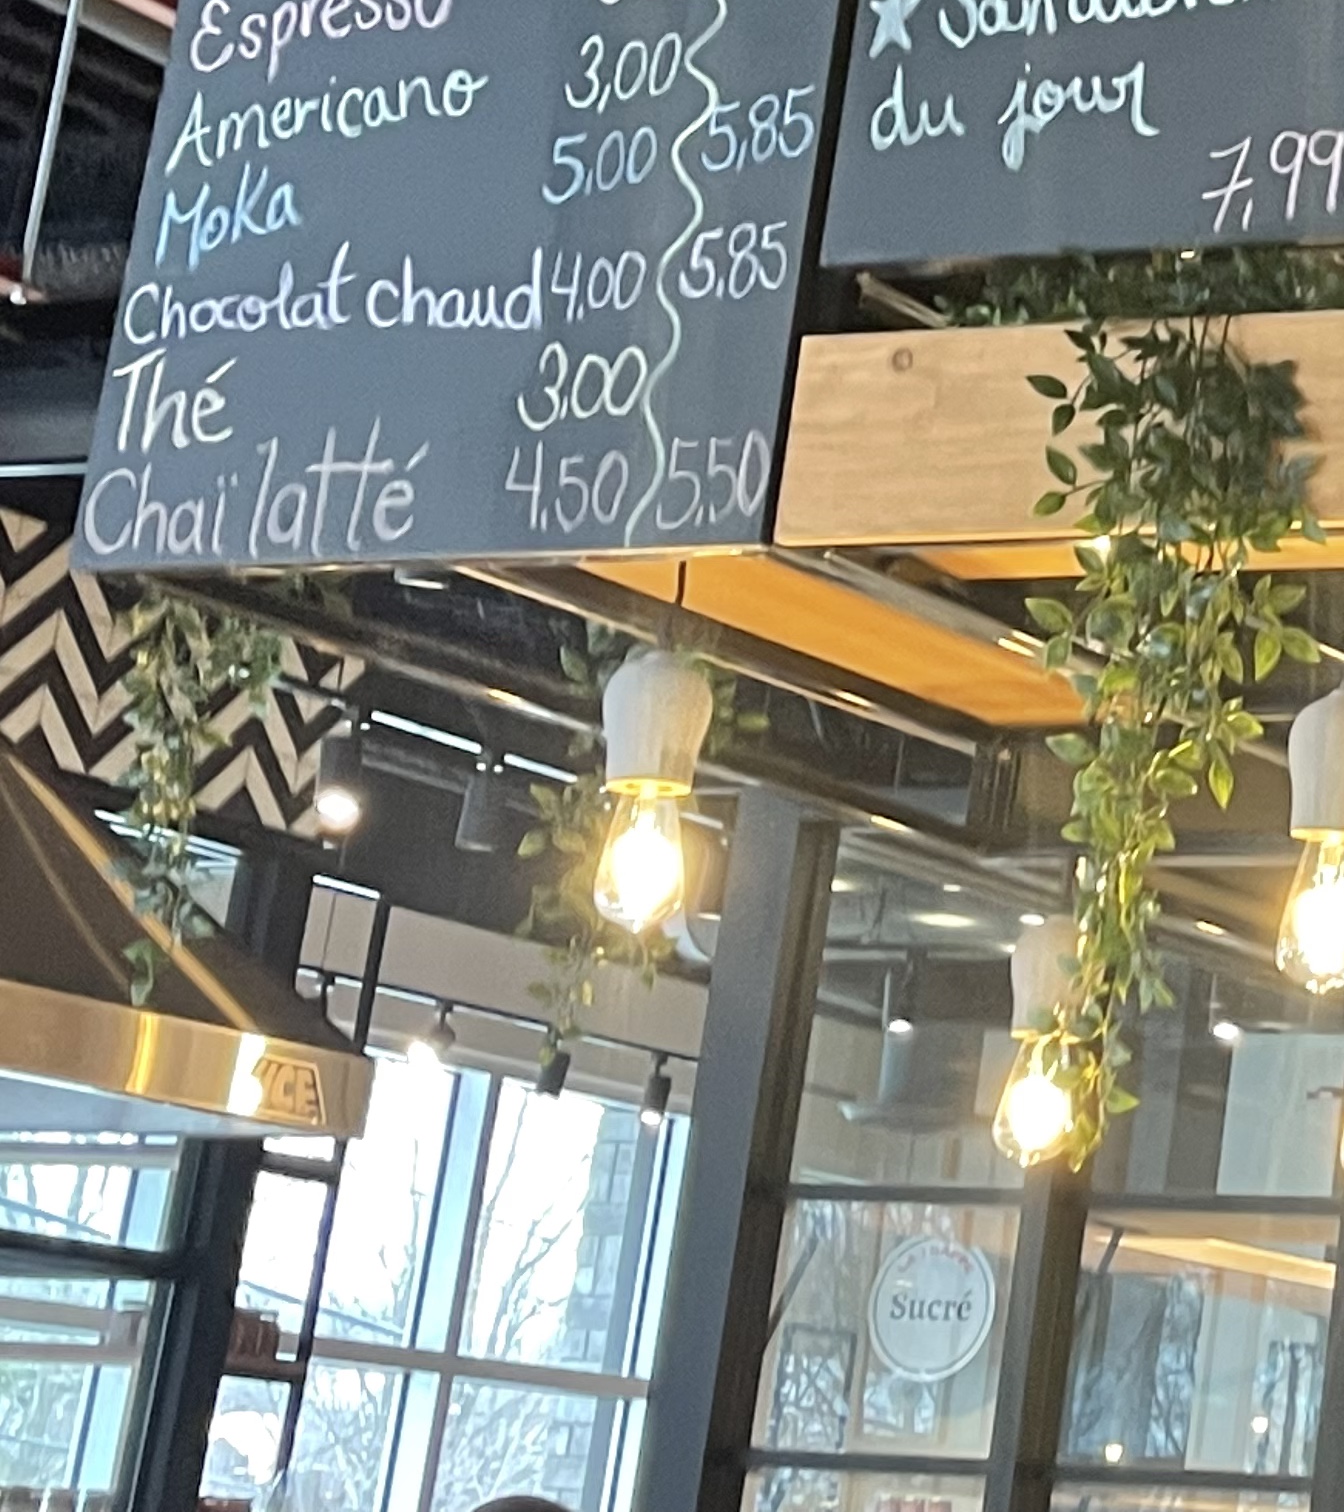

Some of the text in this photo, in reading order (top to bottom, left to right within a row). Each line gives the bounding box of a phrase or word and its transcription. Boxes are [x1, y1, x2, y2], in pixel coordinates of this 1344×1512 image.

[164, 68, 488, 176] Americano
[870, 60, 1159, 170] du jour
[124, 242, 356, 345] Chocolat
[366, 248, 543, 331] chaud
[112, 348, 238, 452] Thé
[248, 416, 430, 559] latté
[889, 1290, 973, 1322] Sucré
